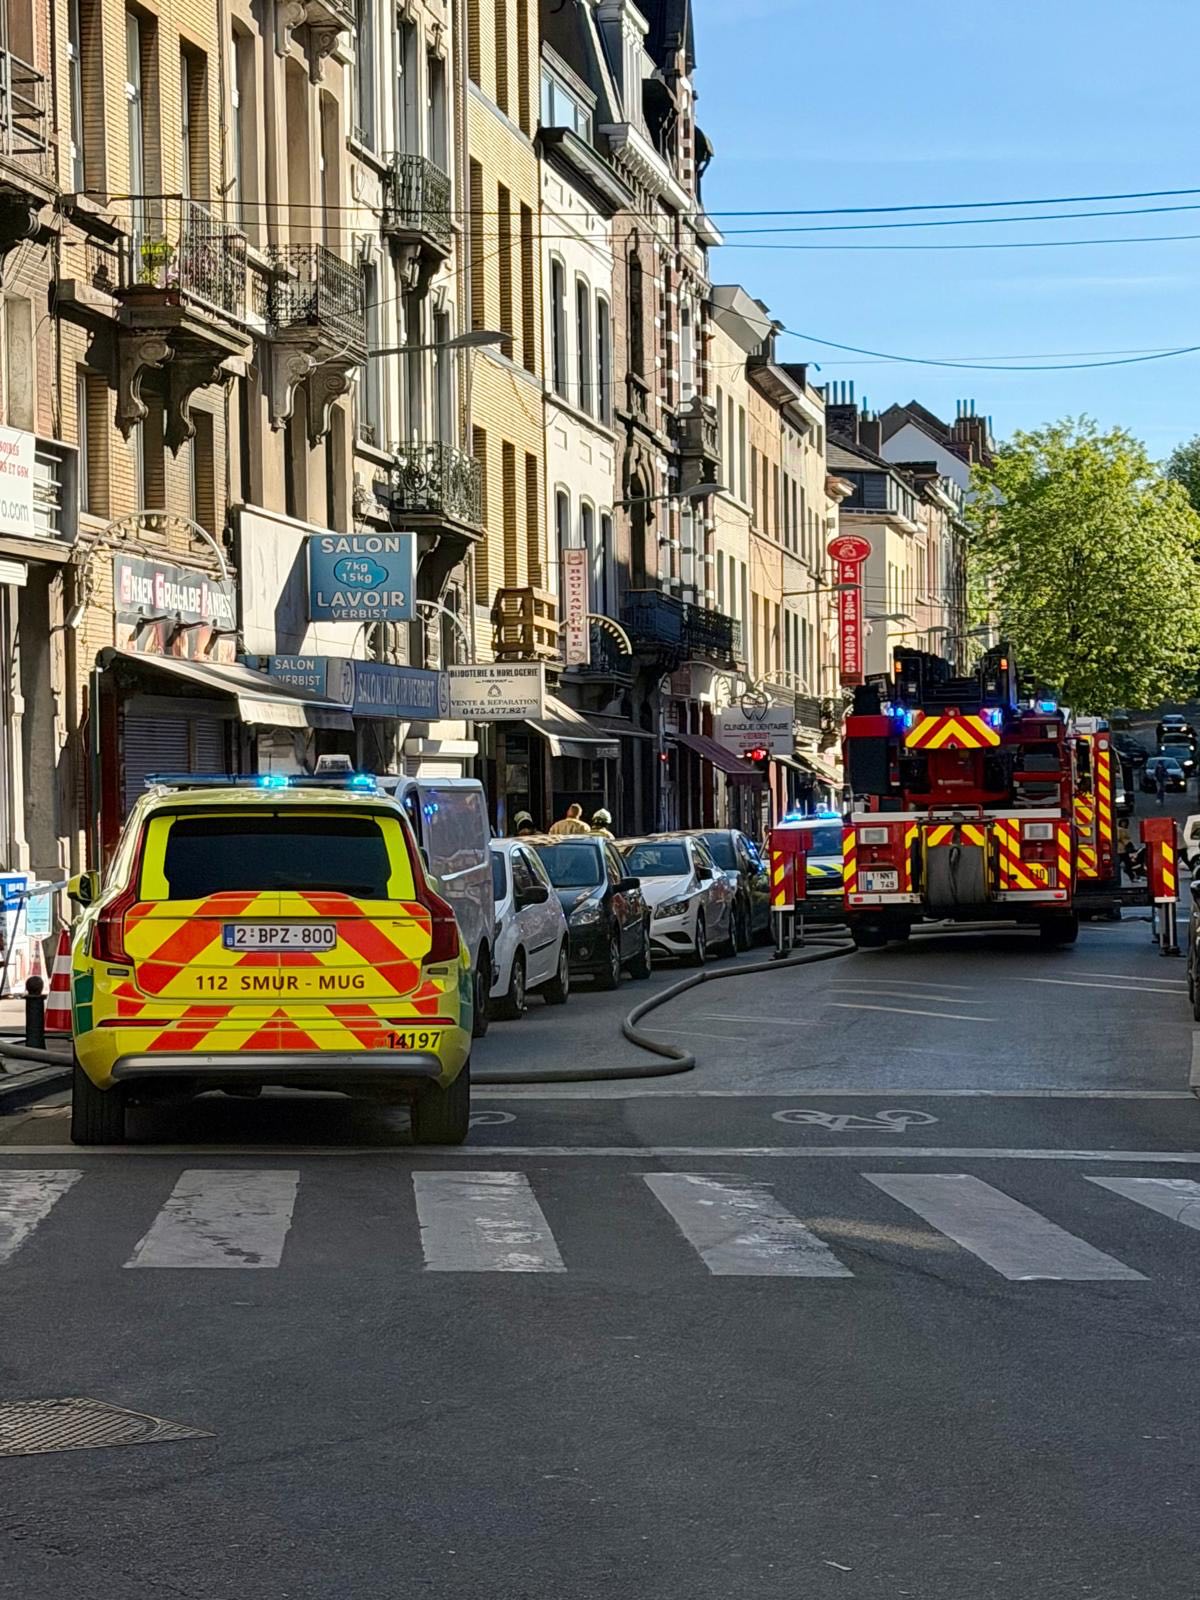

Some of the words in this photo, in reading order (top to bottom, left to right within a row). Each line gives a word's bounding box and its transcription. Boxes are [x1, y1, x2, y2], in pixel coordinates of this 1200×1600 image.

[321, 537, 400, 553] SALON
[345, 562, 368, 573] 7kg
[342, 573, 373, 583] 15kg
[120, 565, 154, 605] SNACK
[154, 572, 201, 613] GRILLADE
[317, 591, 405, 607] LAVOIR
[332, 609, 388, 618] VERBIST
[569, 569, 582, 647] BOULANGERIE
[275, 659, 315, 670] SALON
[450, 669, 488, 678] BIJOUTERIE
[489, 669, 495, 677] &
[497, 668, 538, 677] HORLOGERIE
[723, 723, 754, 731] CLINIQUE
[196, 975, 228, 990] 112
[240, 976, 299, 990] SMUR
[319, 975, 365, 989] MUG
[387, 1031, 441, 1049] 14197
